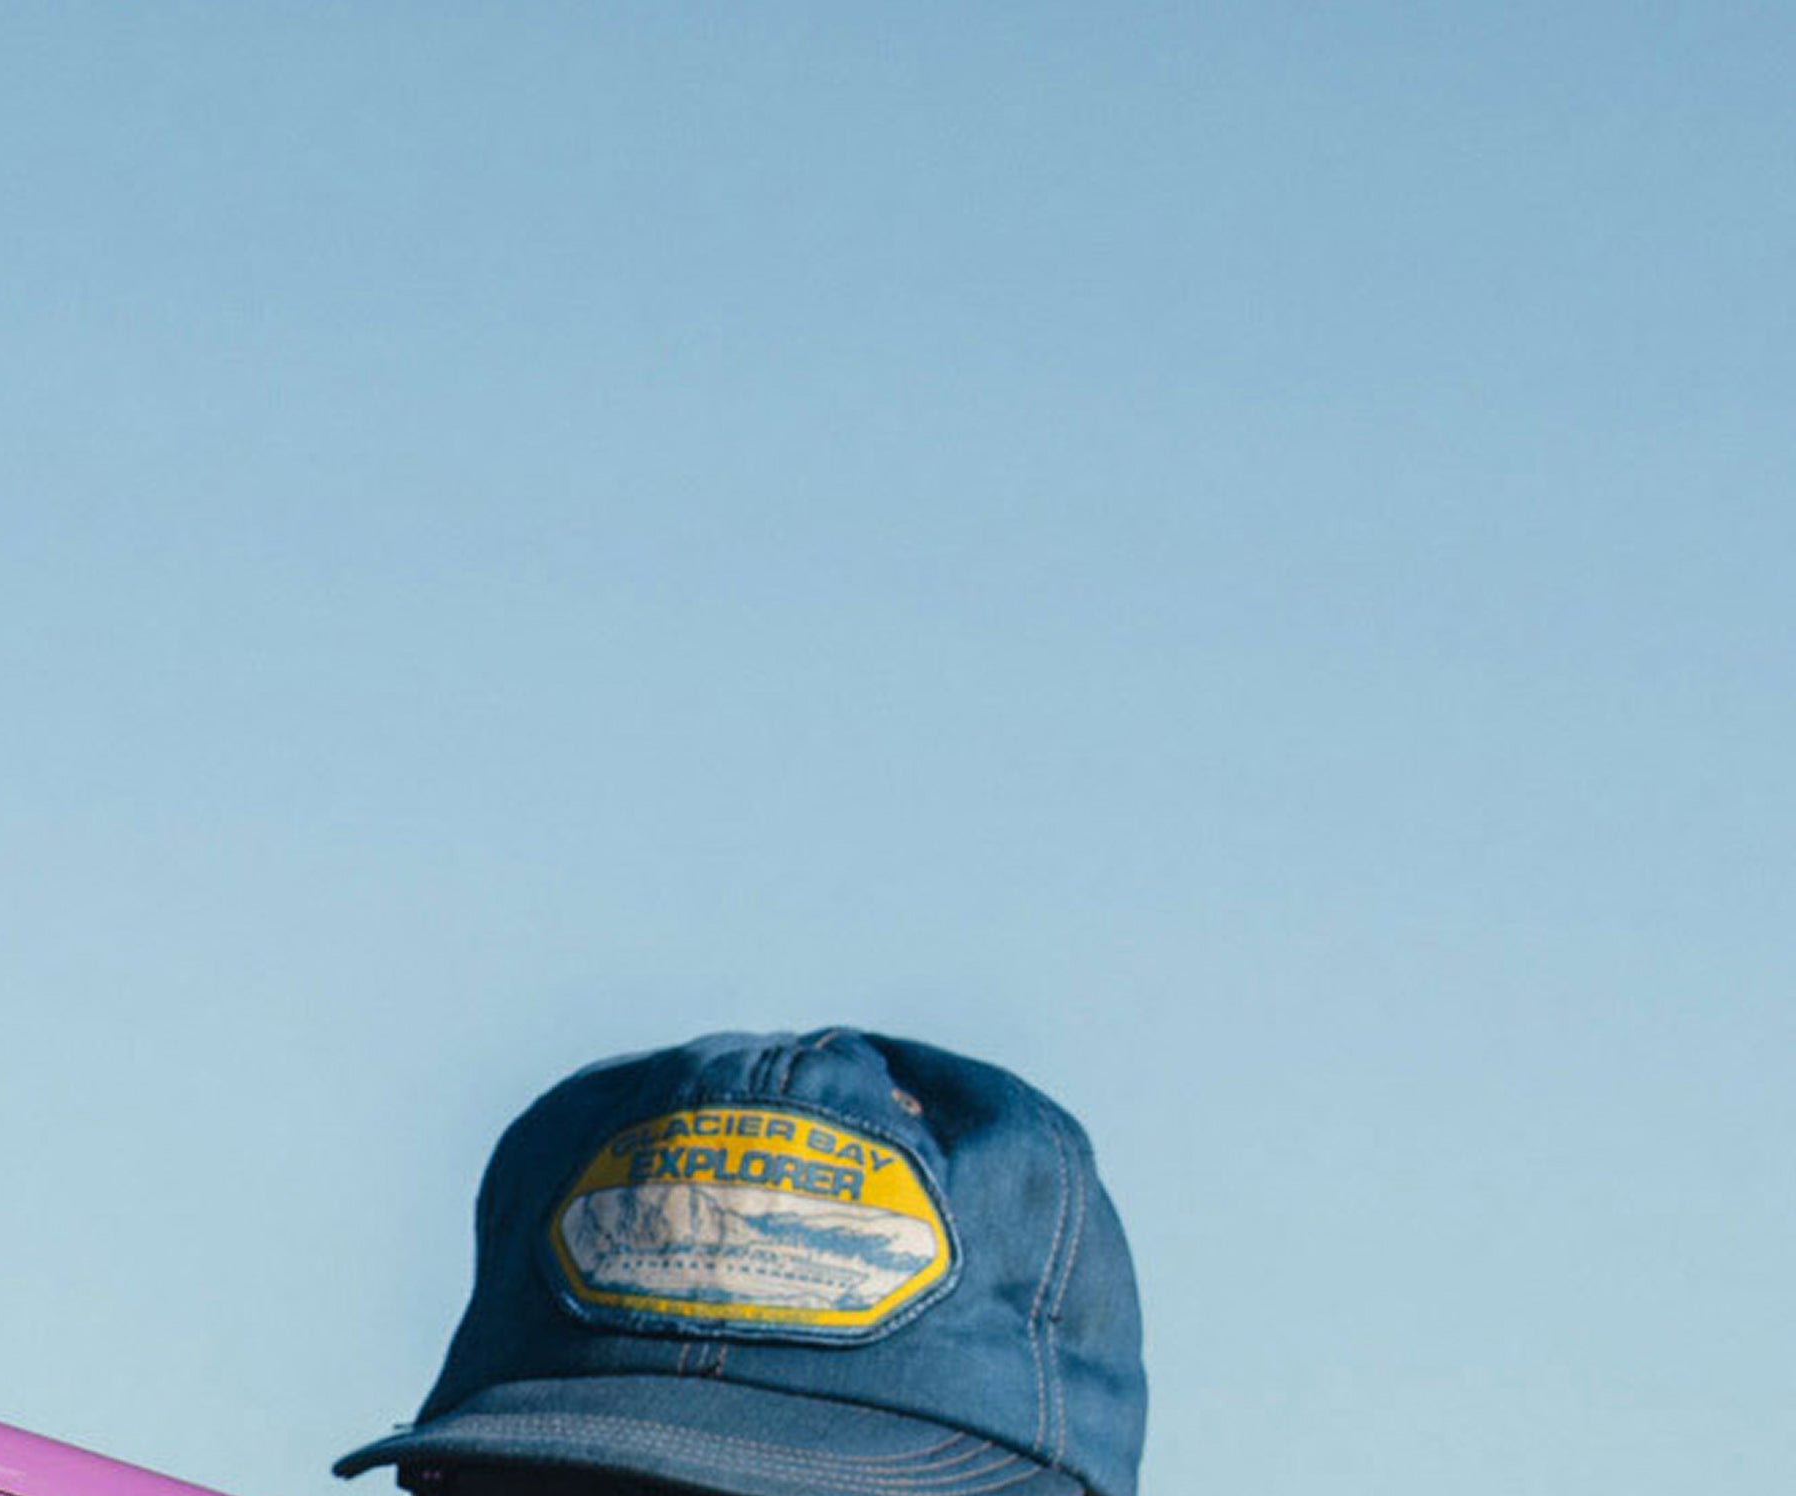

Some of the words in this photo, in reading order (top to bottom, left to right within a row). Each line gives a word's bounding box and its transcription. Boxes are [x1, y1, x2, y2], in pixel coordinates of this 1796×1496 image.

[610, 1112, 797, 1155] GLACIER
[807, 1127, 894, 1172] BAY
[629, 1147, 864, 1200] EXPLORER
